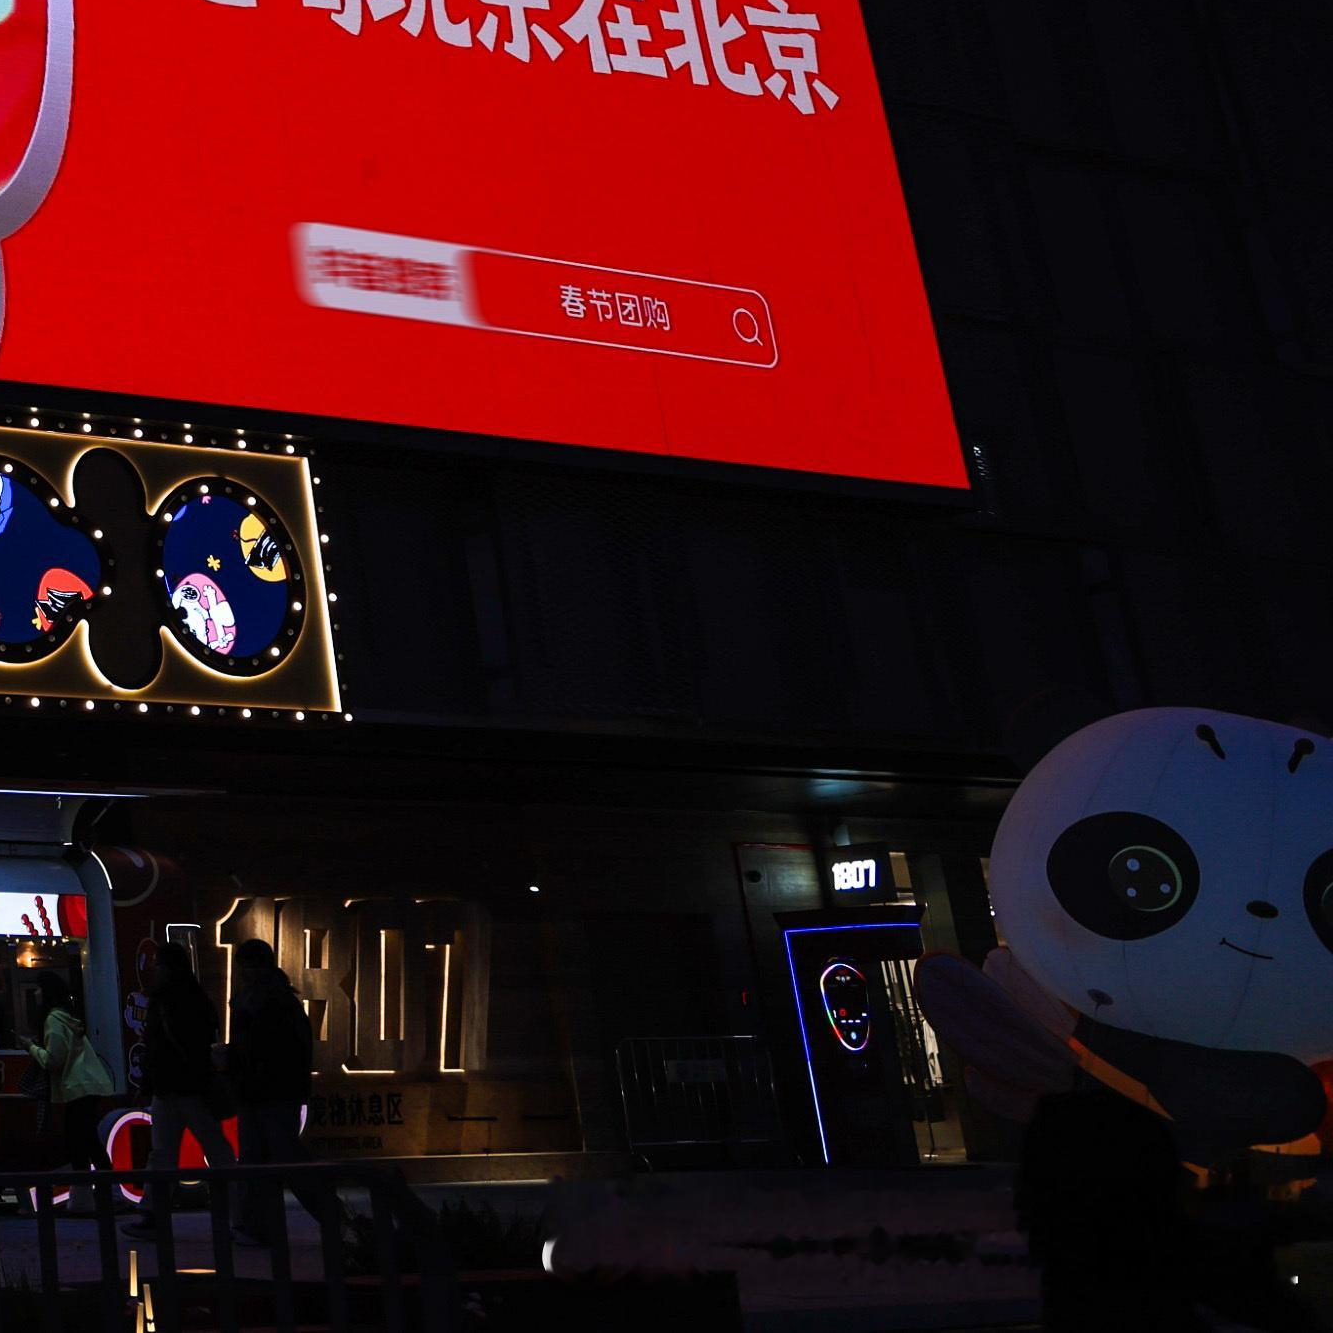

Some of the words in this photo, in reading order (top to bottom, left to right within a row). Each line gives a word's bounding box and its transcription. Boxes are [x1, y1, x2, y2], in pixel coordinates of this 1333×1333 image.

[559, 284, 672, 333] 春节团购
[831, 858, 878, 892] 1807
